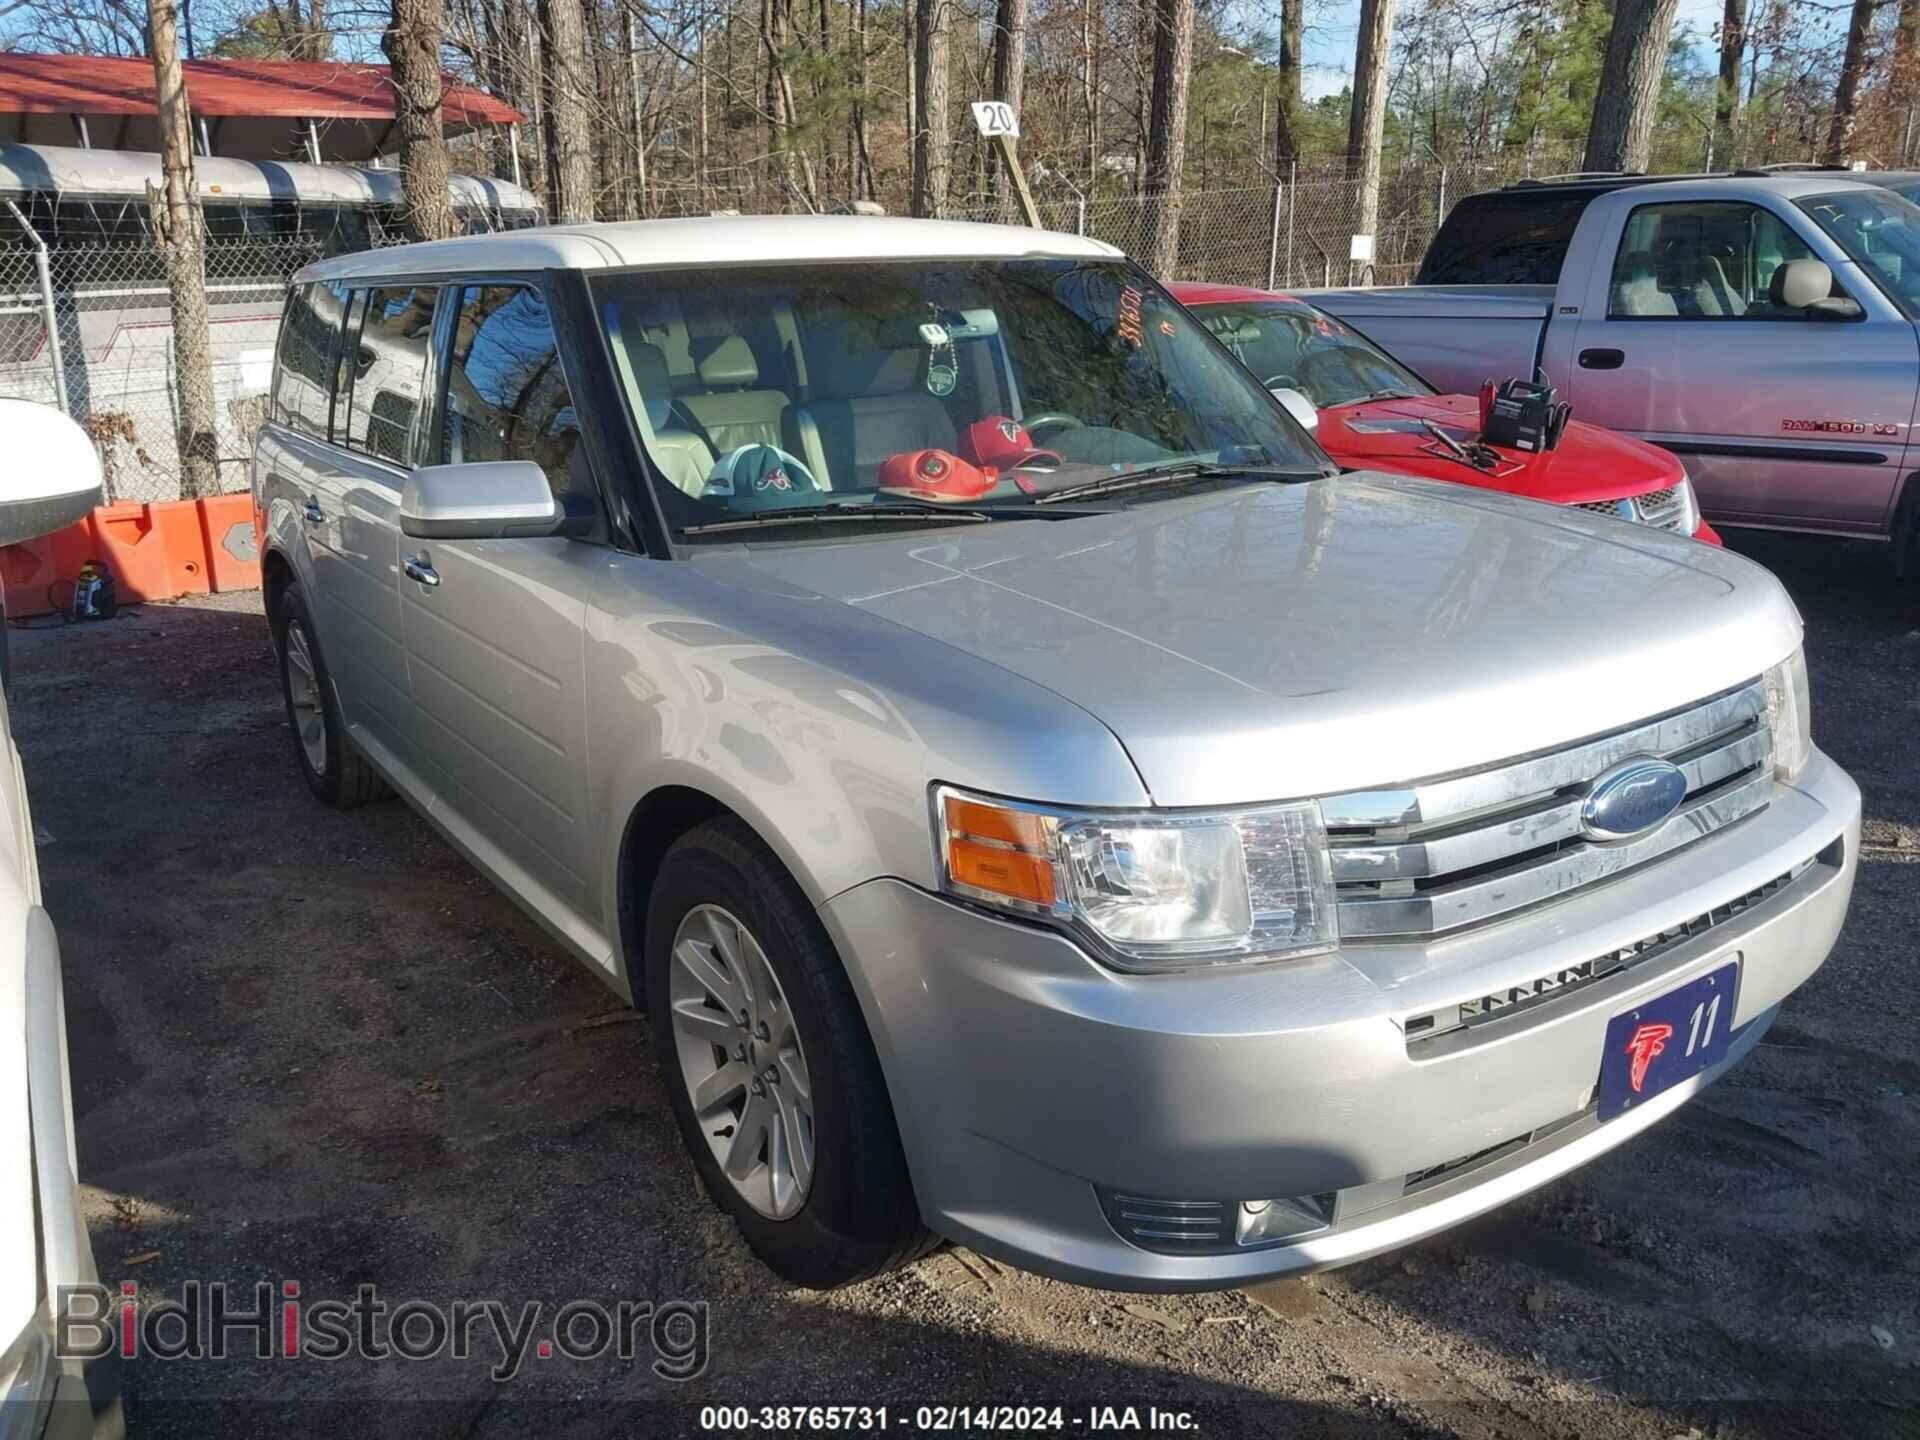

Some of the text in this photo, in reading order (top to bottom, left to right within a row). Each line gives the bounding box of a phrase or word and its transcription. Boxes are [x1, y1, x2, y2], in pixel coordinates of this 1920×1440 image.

[982, 104, 1012, 131] 20
[1781, 419, 1817, 432] RAM
[1822, 421, 1866, 434] 1500
[1684, 993, 1721, 1057] 11
